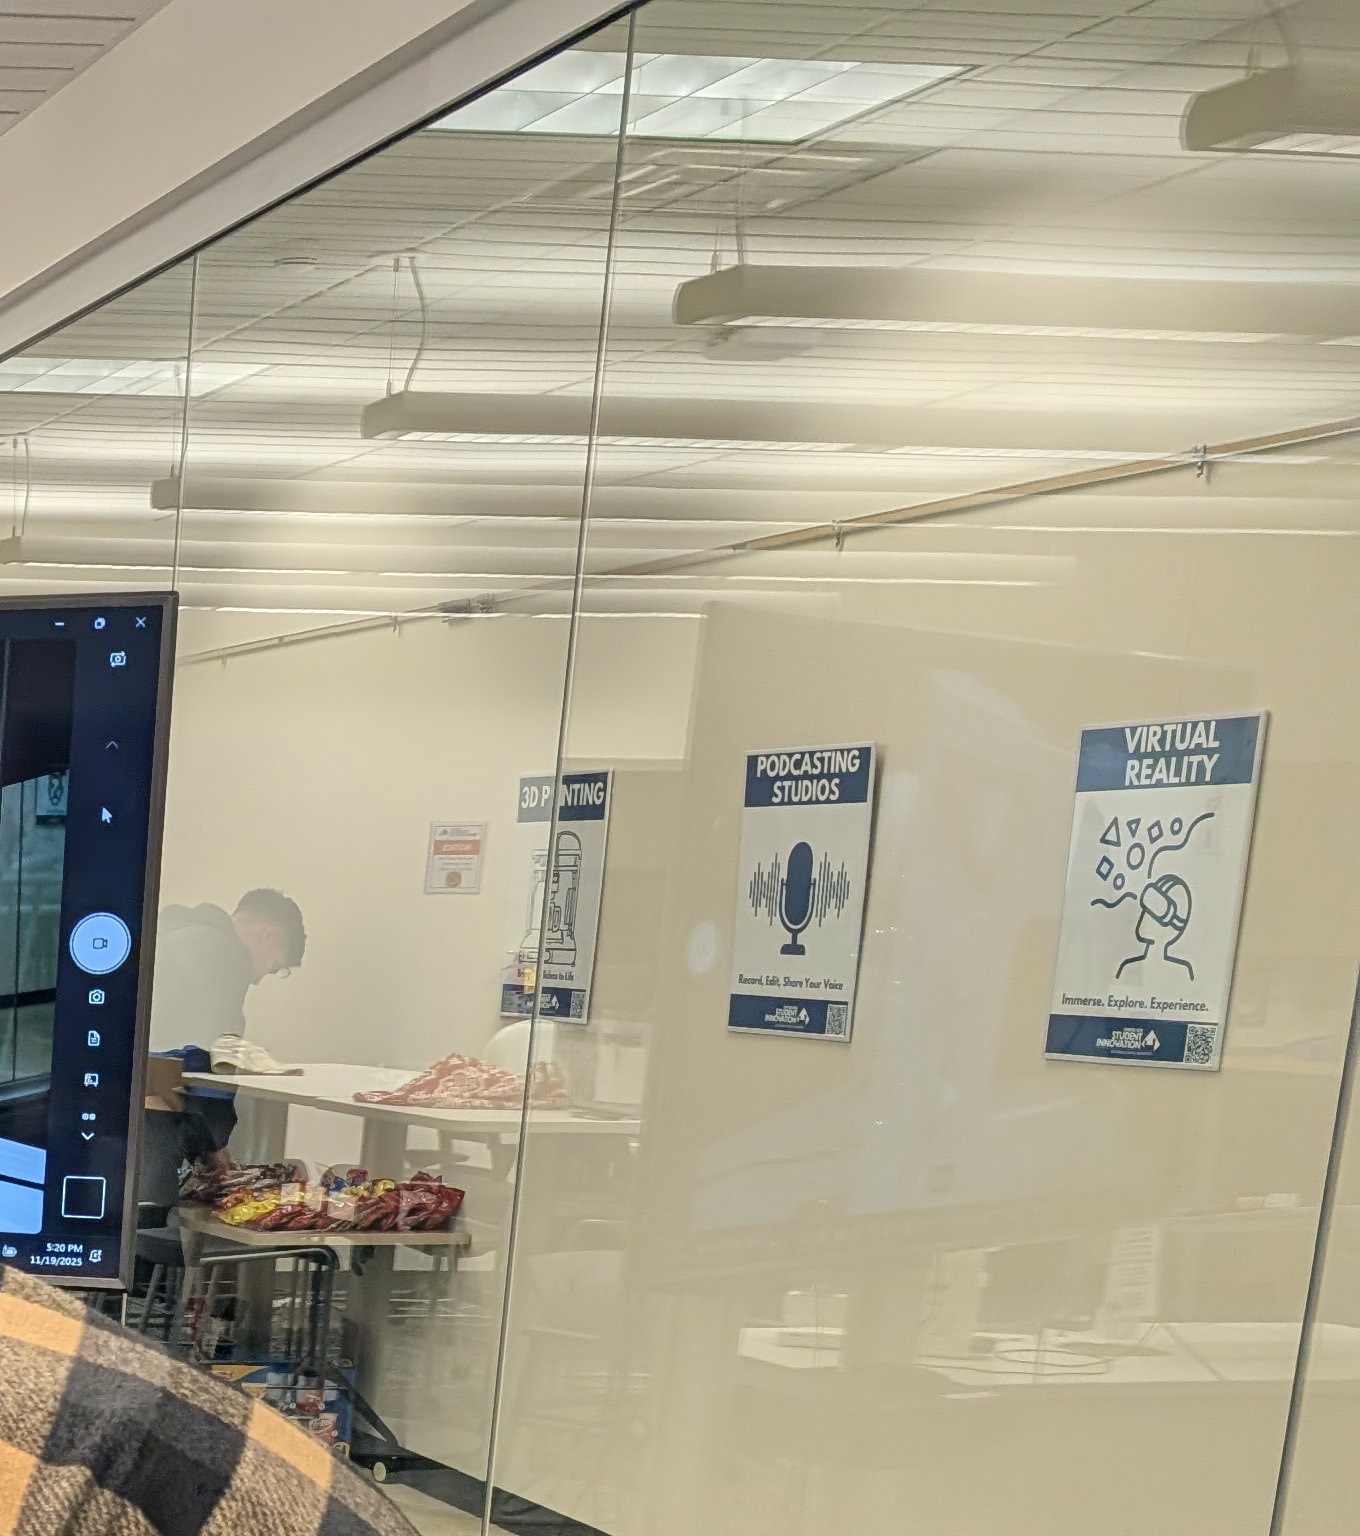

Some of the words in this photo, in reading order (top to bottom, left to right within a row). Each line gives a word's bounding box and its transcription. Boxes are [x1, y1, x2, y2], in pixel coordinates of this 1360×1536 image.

[1124, 720, 1220, 754] VIRTUAL
[756, 749, 860, 778] PODCASTING
[1124, 753, 1220, 787] REALITY
[521, 785, 539, 809] 3D
[540, 781, 605, 808] PNTING
[771, 777, 840, 804] STUDIOS
[738, 973, 764, 986] Record,
[765, 975, 781, 987] Edit,
[783, 976, 803, 988] Share
[804, 977, 822, 988] Your
[824, 978, 844, 990] Voice
[1061, 992, 1105, 1007] Immerse.
[1107, 994, 1148, 1010] Explore.
[1150, 996, 1209, 1013] Experience.
[29, 1255, 83, 1267] 11/19/2025
[46, 1242, 66, 1253] 5:20
[67, 1243, 83, 1254] PM
